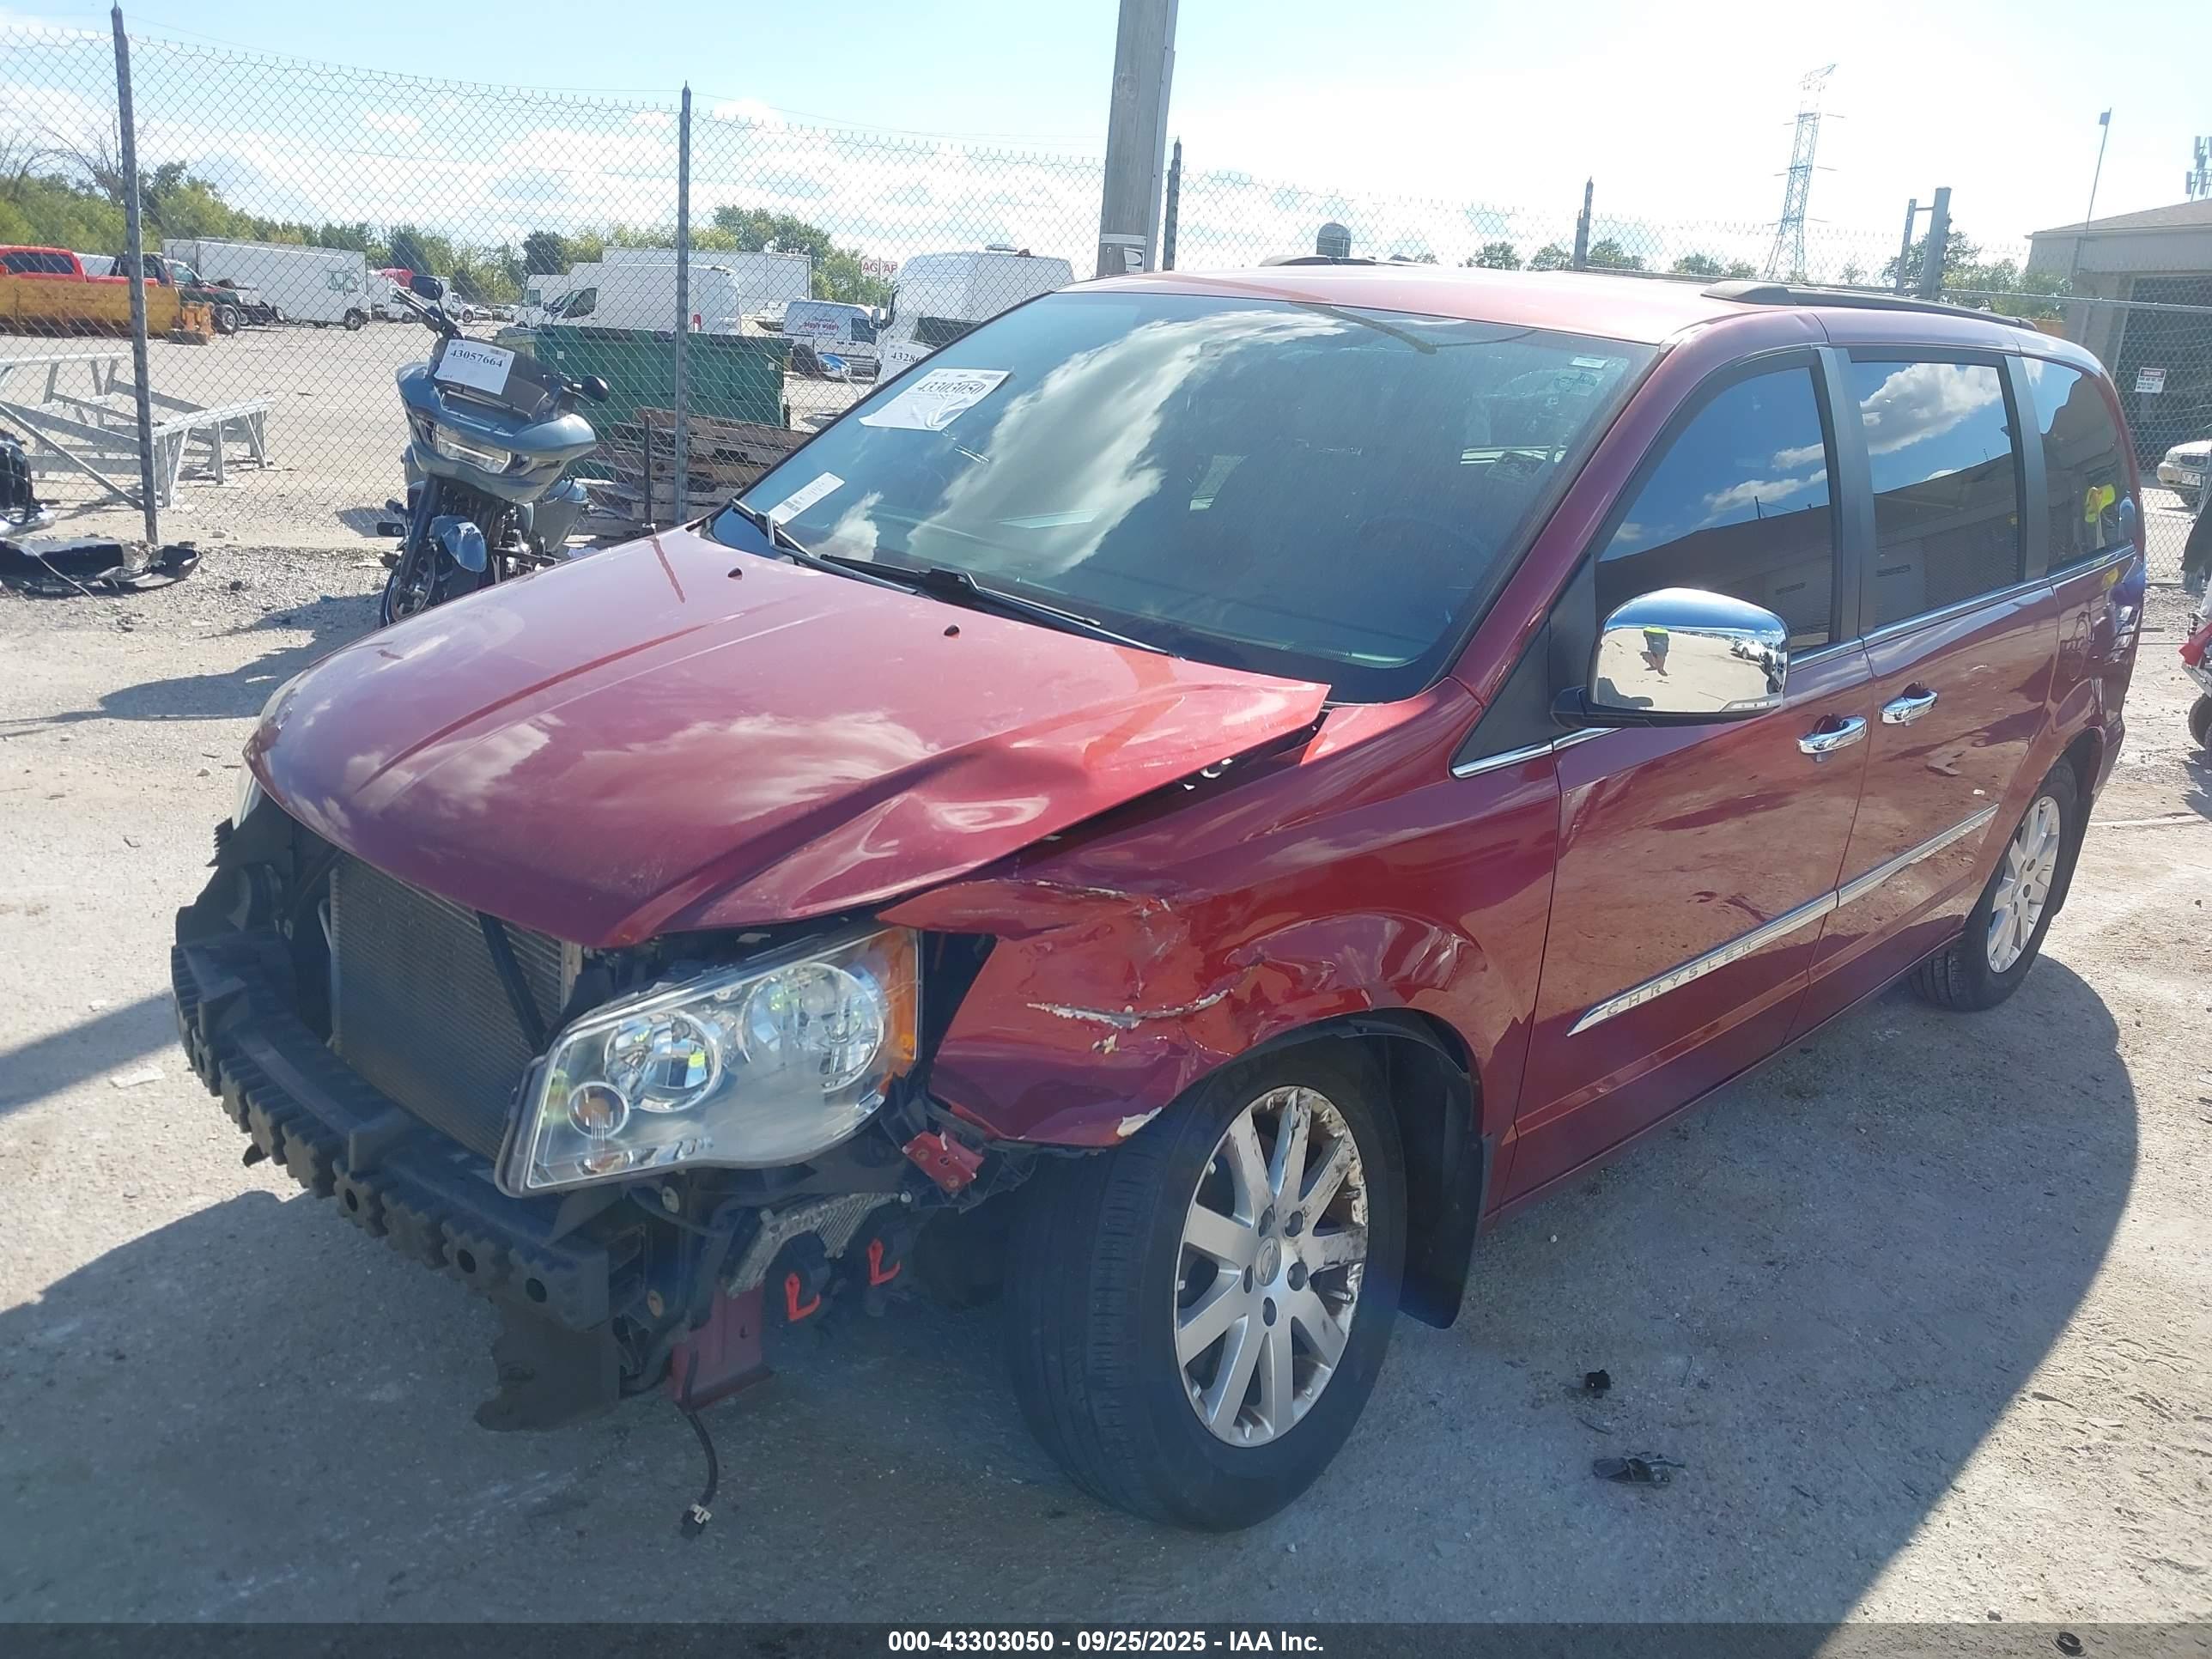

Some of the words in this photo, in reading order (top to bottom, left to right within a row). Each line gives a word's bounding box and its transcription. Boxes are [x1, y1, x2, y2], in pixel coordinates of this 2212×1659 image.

[450, 349, 503, 368] 43057664
[917, 381, 987, 395] 43303050
[1607, 941, 1752, 1017] CHRYSLER
